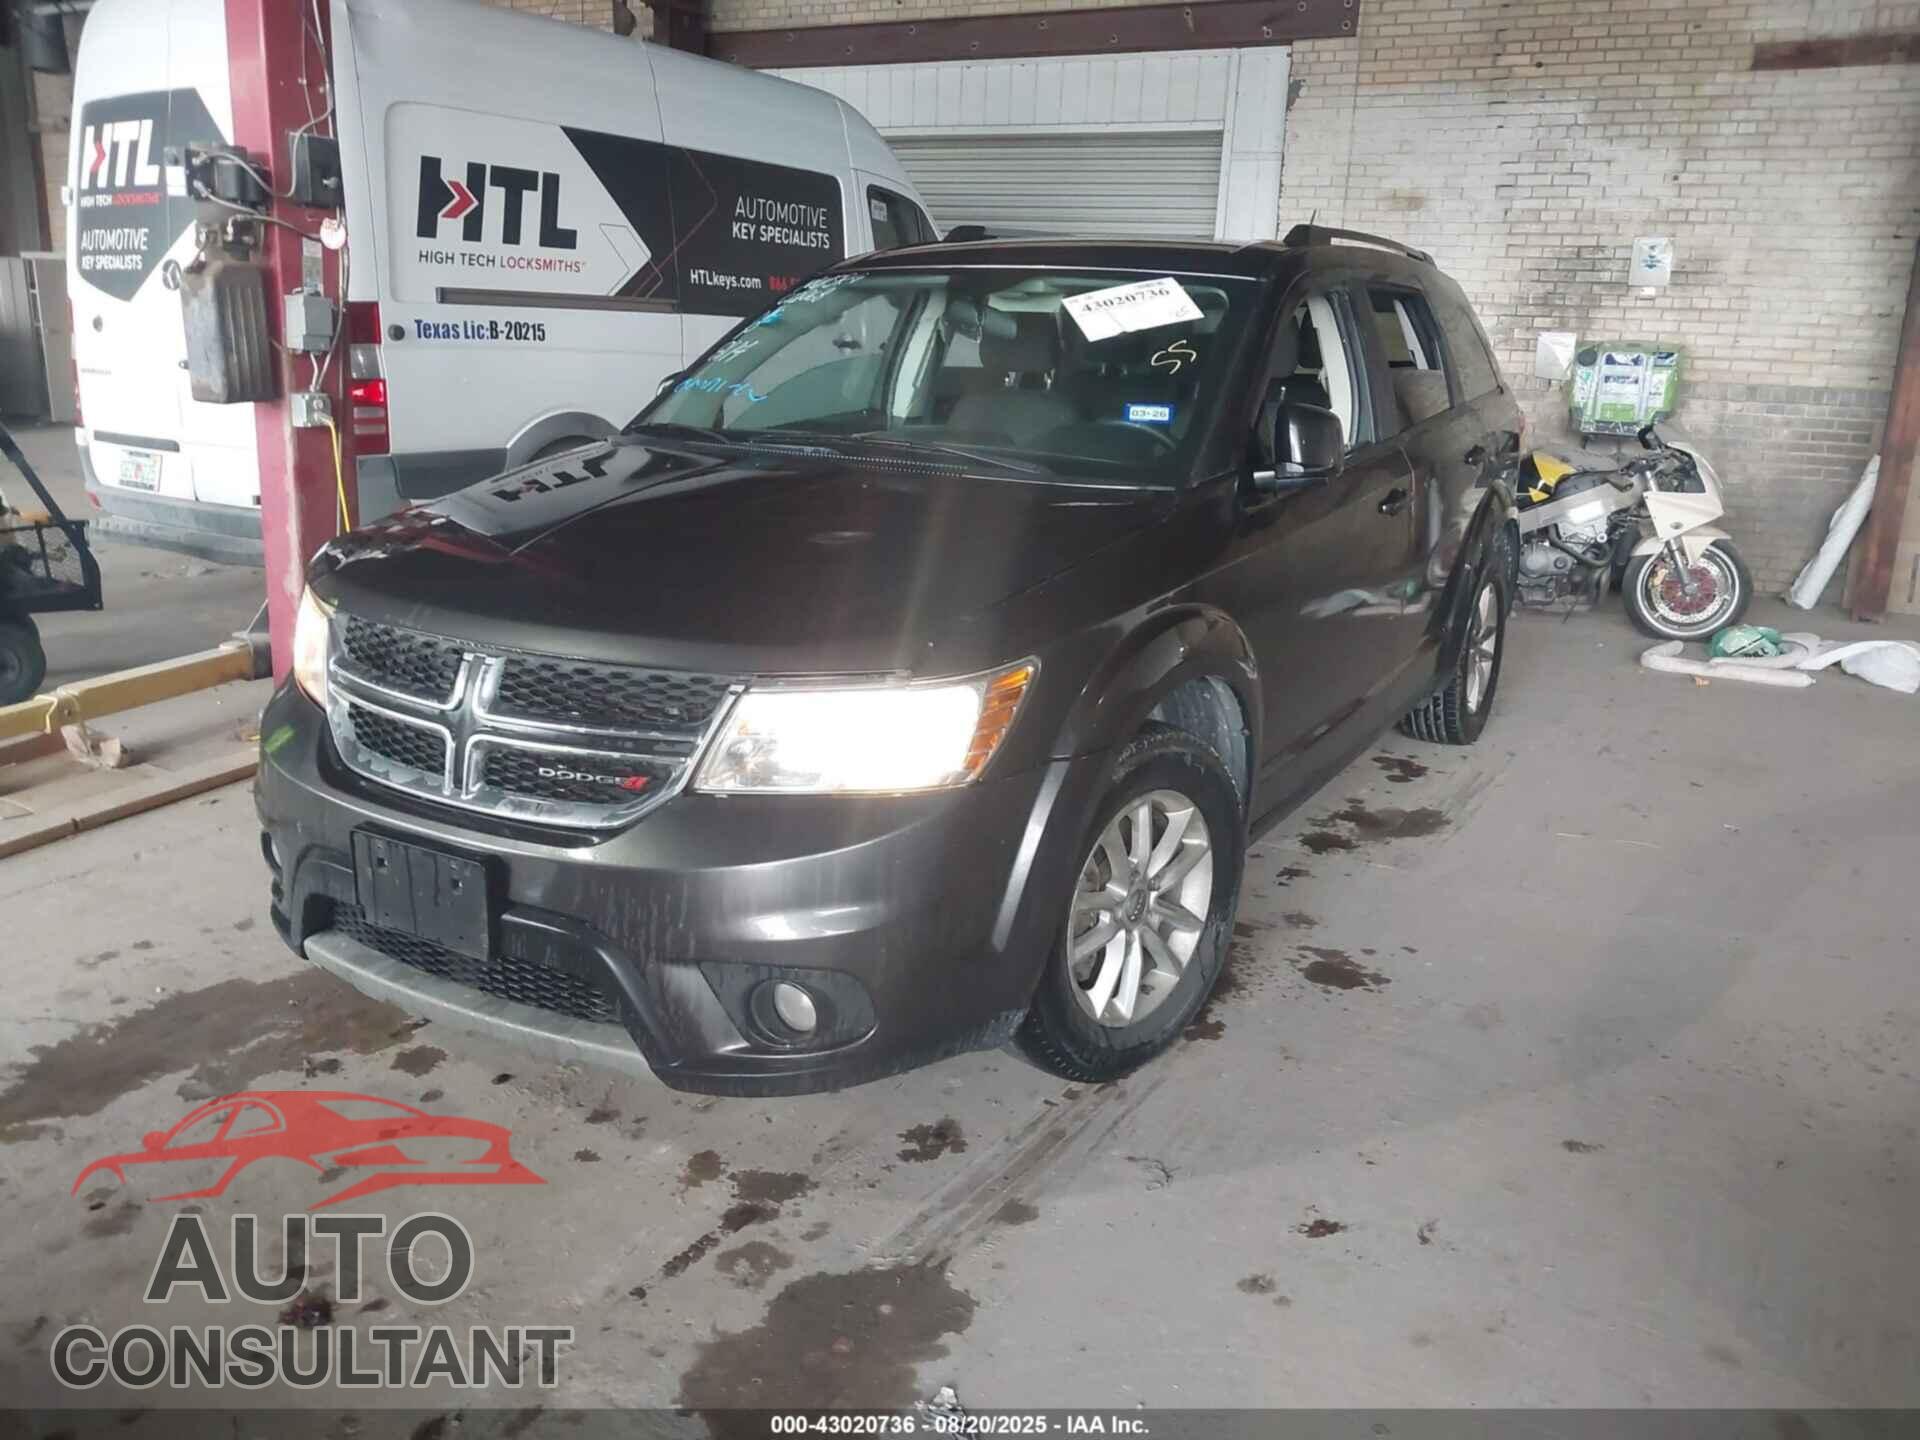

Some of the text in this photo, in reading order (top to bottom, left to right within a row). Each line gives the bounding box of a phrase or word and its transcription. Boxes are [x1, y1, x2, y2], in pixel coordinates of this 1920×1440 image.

[79, 119, 160, 190] HTL
[416, 155, 578, 250] HTL
[734, 195, 829, 229] AUTOMOTIVE
[80, 228, 149, 251] AUTOMOTIVE
[732, 221, 831, 249] KEY SPECIALISTS
[81, 254, 143, 270] KEY SPECIALISTS
[418, 250, 582, 273] HIGH TECH LOCKSMITHS
[690, 268, 762, 290] HTLkeys.com
[1081, 287, 1171, 313] 43020736
[414, 319, 460, 341] Texas
[538, 767, 624, 787] DODGE
